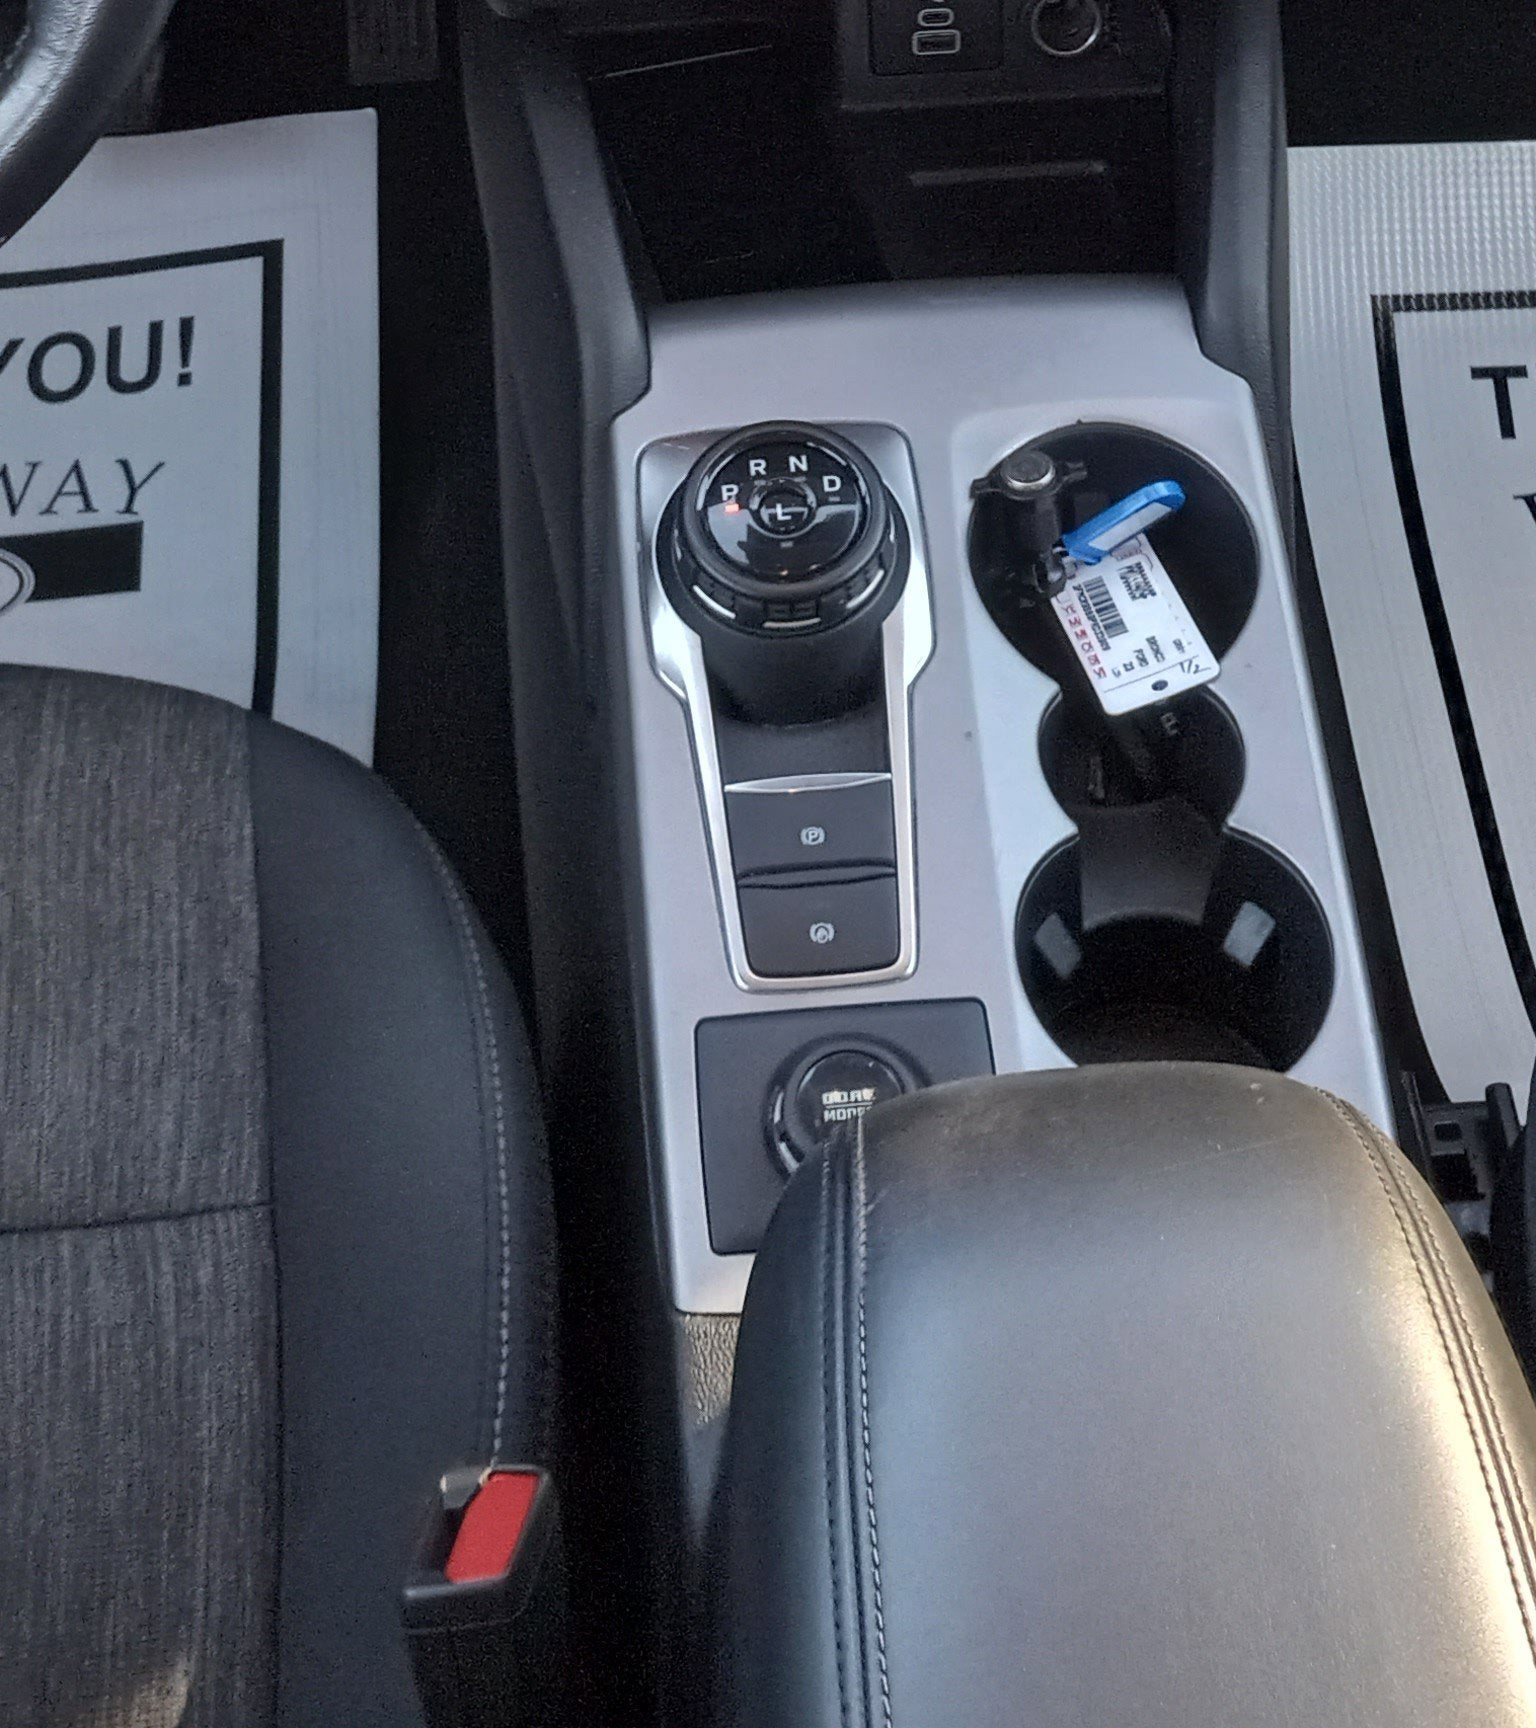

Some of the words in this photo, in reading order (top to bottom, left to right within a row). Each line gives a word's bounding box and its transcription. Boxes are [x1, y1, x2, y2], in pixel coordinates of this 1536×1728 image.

[749, 459, 767, 477] R
[789, 455, 809, 473] N
[720, 483, 739, 501] P
[822, 475, 842, 493] D
[775, 503, 792, 521] L
